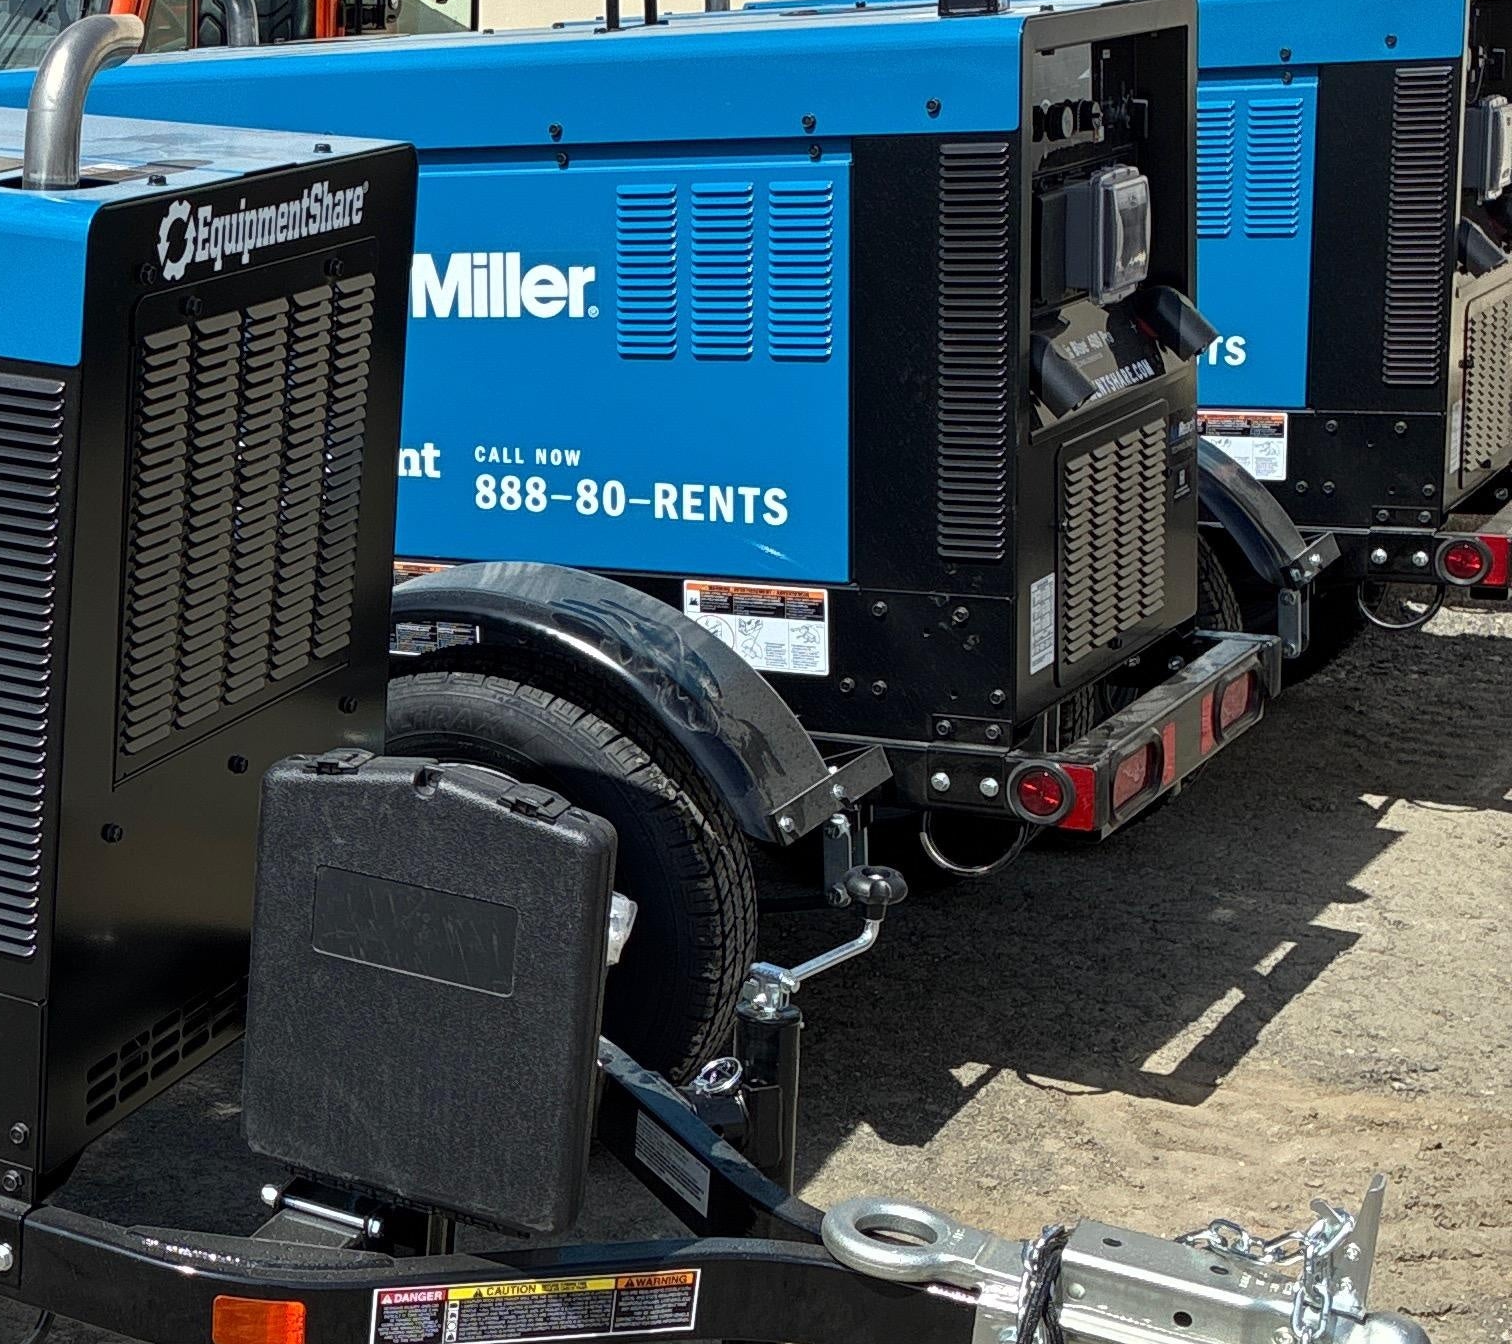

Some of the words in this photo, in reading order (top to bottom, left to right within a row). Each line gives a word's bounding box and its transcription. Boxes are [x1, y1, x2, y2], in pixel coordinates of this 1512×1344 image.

[194, 181, 365, 272] EquipmentShare
[411, 251, 596, 319] Miller
[474, 445, 525, 465] CALL
[535, 447, 582, 468] NOW
[474, 474, 789, 527] 888-80-RENTS
[486, 1283, 537, 1297] CAUTION
[636, 1274, 688, 1286] WARNING
[394, 1290, 443, 1303] DANGER
